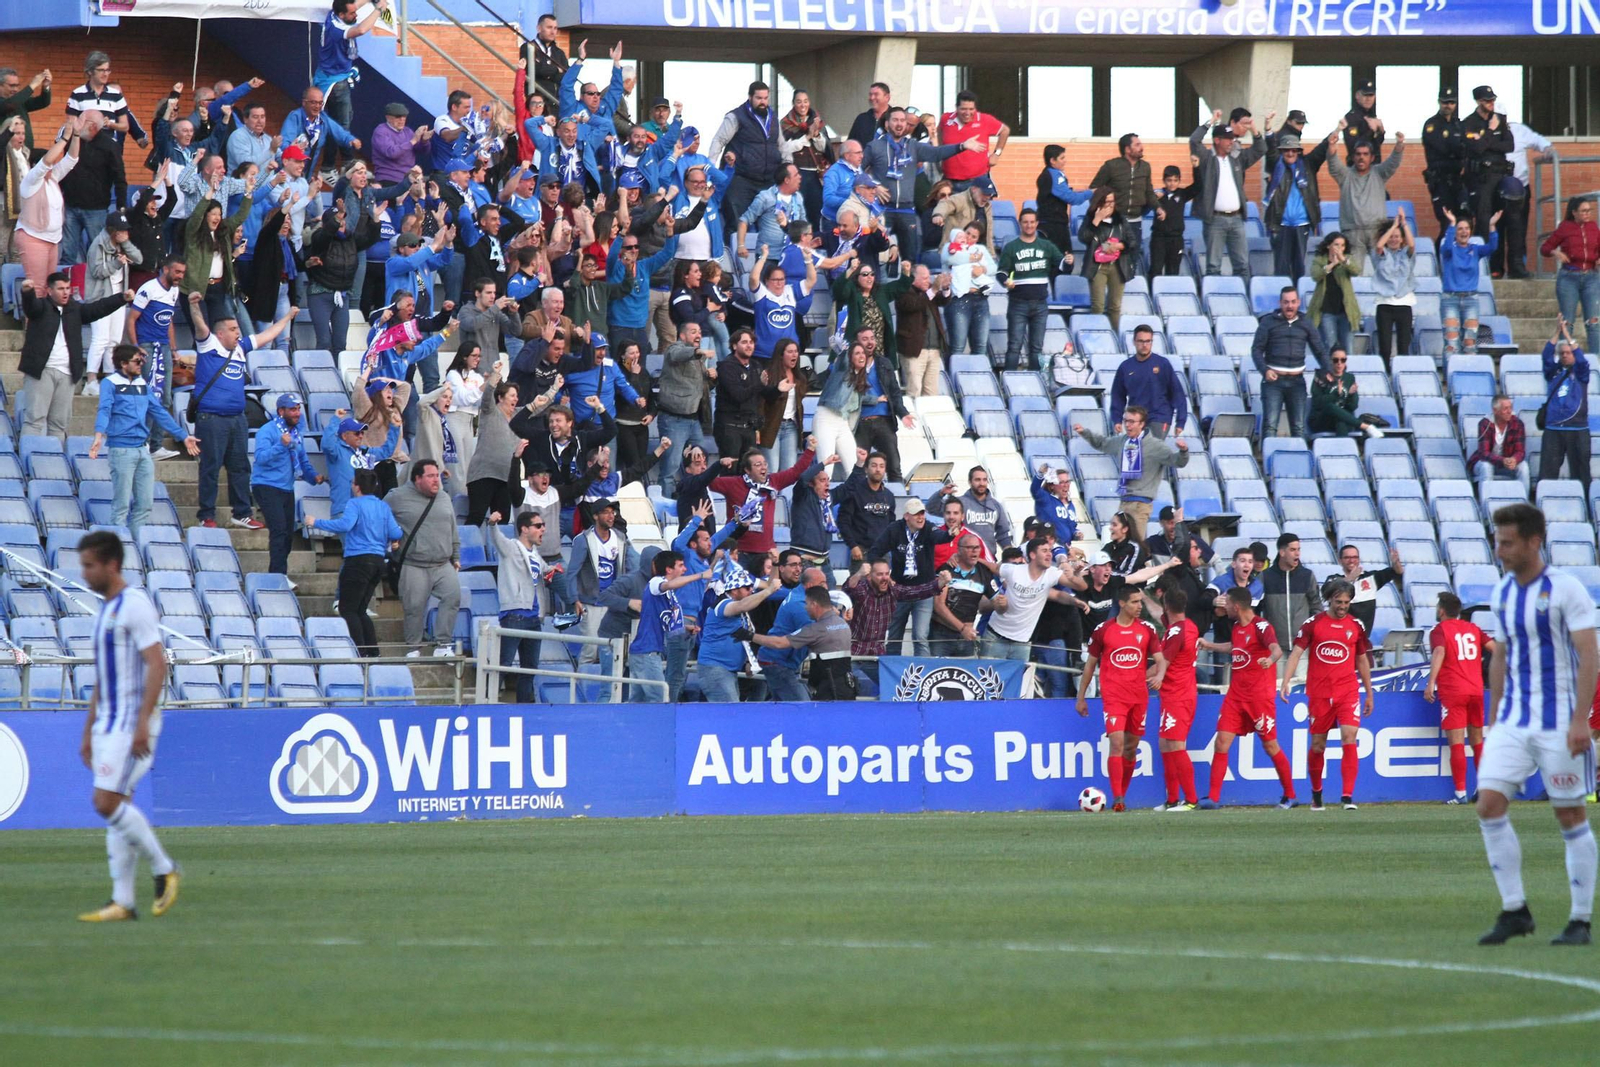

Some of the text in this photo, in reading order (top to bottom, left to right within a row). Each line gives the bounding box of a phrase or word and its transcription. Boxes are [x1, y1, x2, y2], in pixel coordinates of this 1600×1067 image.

[1222, 0, 1279, 36] del
[1016, 248, 1035, 260] LOST
[1031, 260, 1047, 270] HERE
[966, 509, 998, 525] ORGULLO
[1320, 646, 1344, 658] COASA
[1455, 633, 1478, 661] 16
[1115, 653, 1139, 662] COASA
[379, 716, 567, 791] WiHu
[688, 733, 974, 796] Autoparts
[1552, 775, 1575, 787] KIA
[398, 791, 564, 812] INTERNET Y TELEFONÍA
